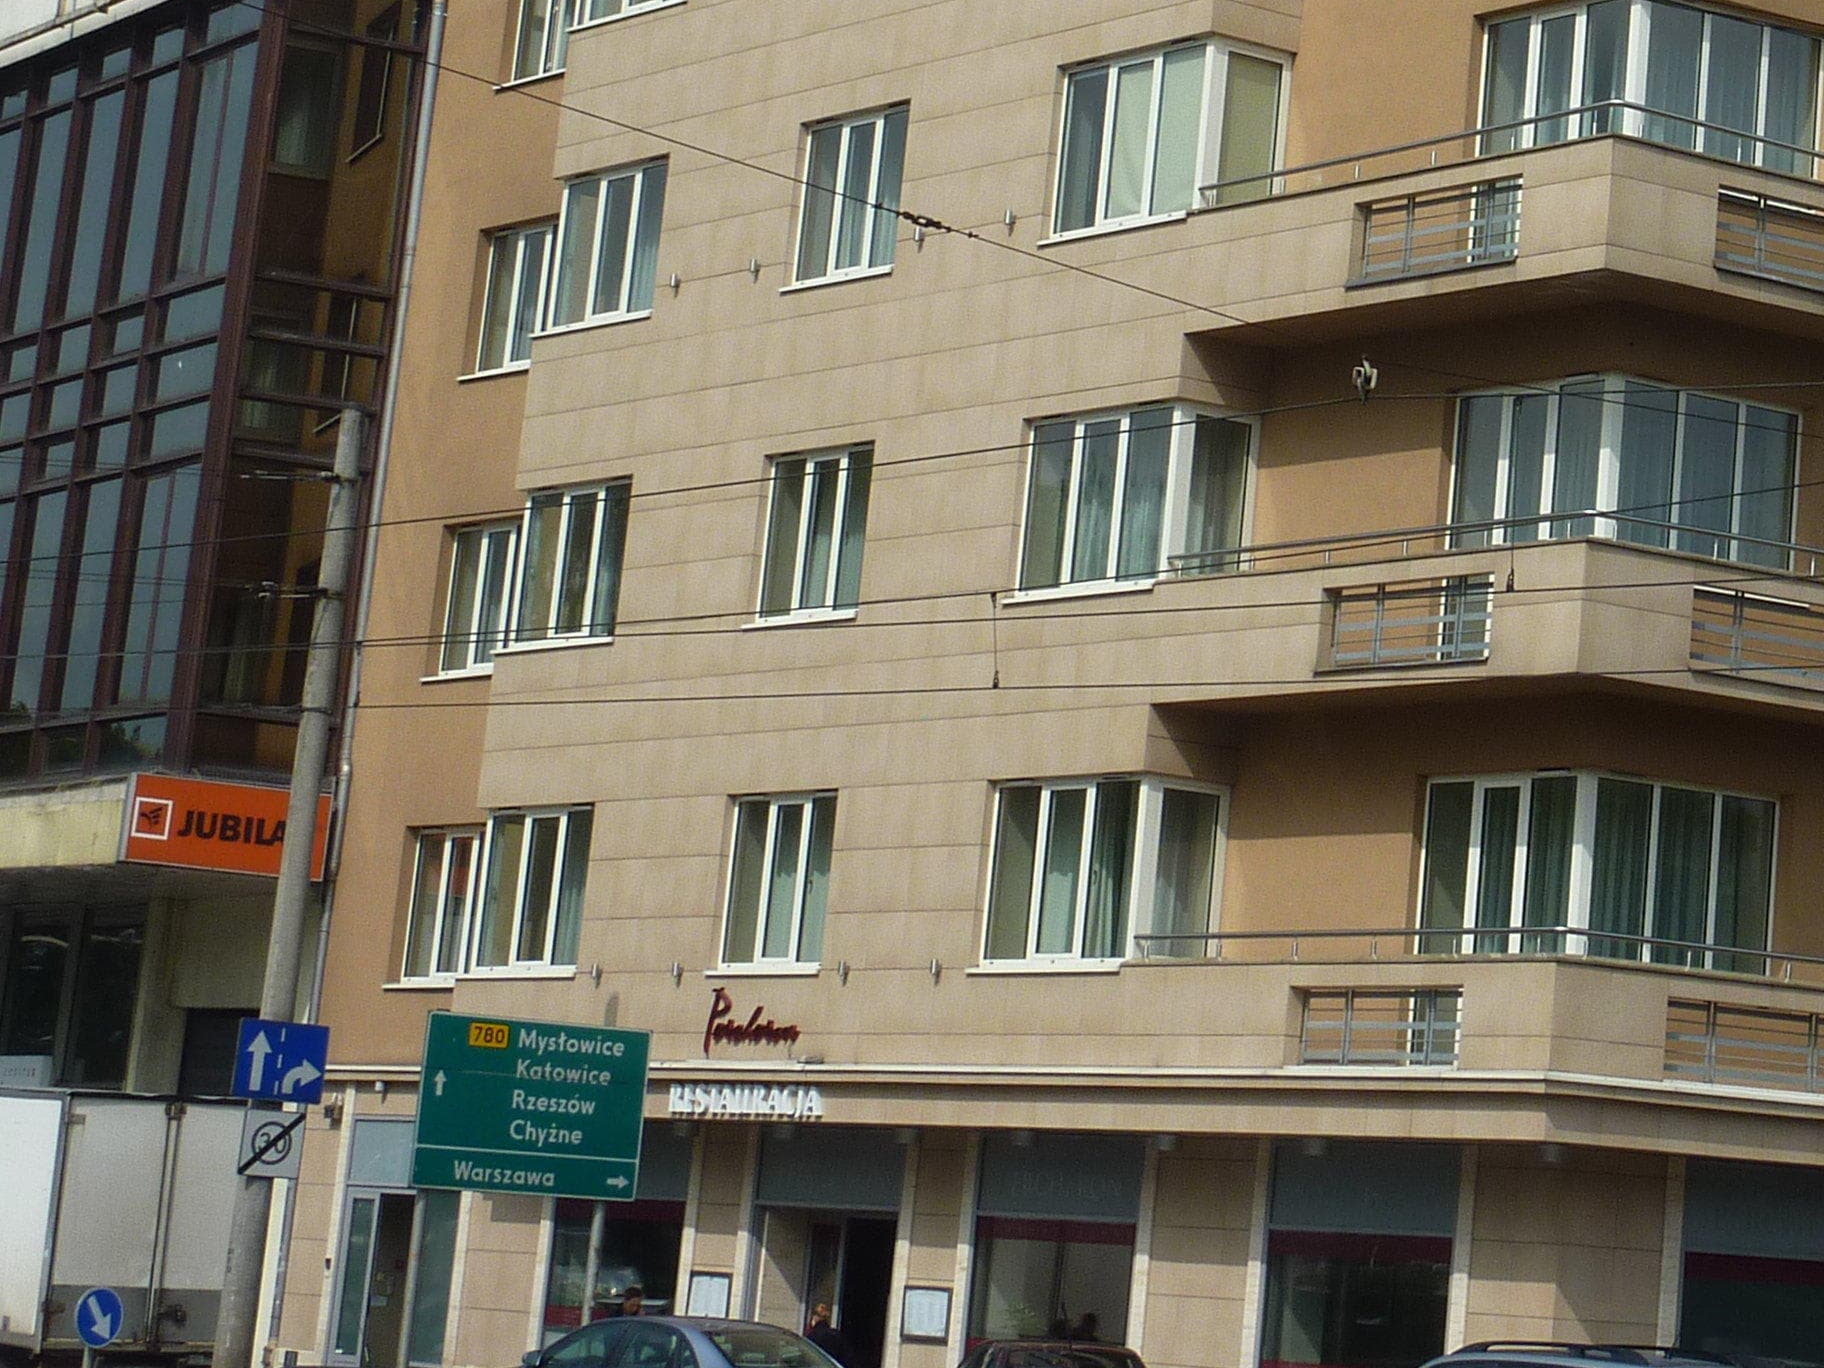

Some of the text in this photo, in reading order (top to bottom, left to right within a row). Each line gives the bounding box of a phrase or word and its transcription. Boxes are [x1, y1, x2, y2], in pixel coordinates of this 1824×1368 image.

[473, 1025, 625, 1057] 780 Mysłowice
[515, 1058, 611, 1087] Katowice
[512, 1089, 596, 1116] Rzeszów
[668, 1083, 824, 1118] RESTAURACJA
[509, 1119, 583, 1148] Chyżne
[454, 1160, 555, 1188] Warszawa
